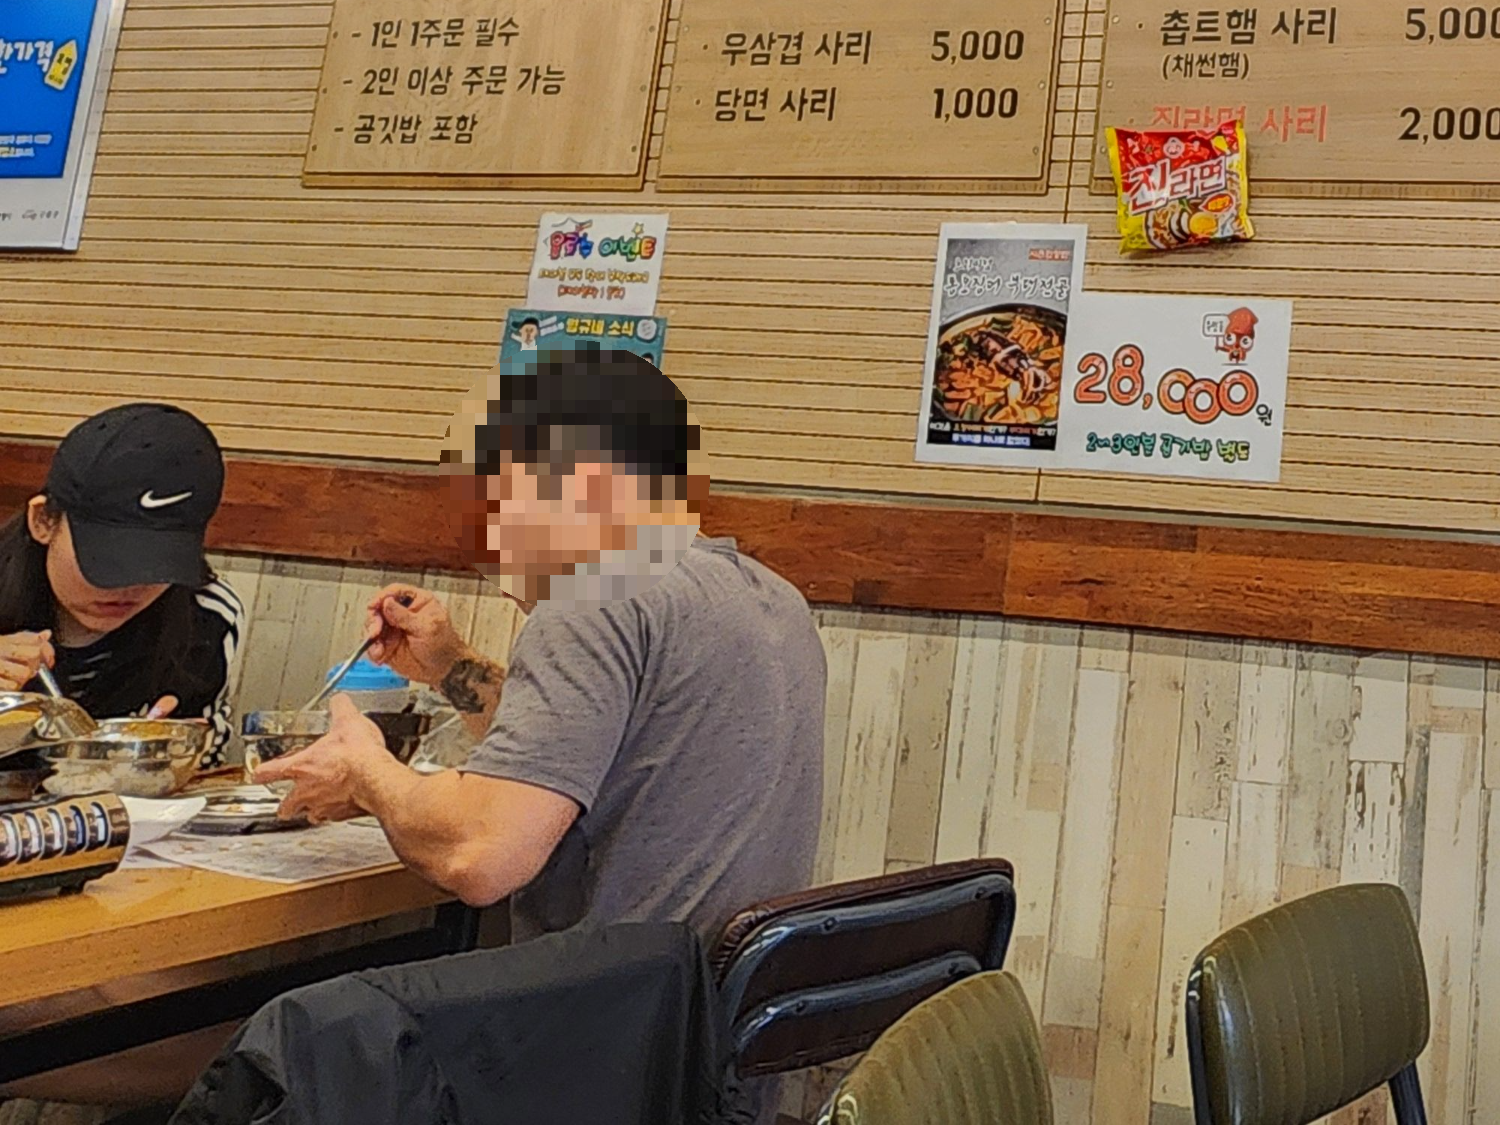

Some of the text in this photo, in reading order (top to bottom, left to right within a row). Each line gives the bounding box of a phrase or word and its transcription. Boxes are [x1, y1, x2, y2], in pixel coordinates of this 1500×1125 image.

[371, 17, 520, 48] 1인 1주문 필수
[1271, 7, 1338, 44] 사리
[721, 30, 1025, 66] 우삼겹 사리 5,000
[1162, 52, 1250, 79] (채썬햄)
[361, 65, 566, 96] 2인 이상 주문 가능
[715, 87, 1019, 122] 당면 사리 1,000
[354, 114, 478, 144] 공깃밥 포함
[1259, 105, 1328, 142] 사리
[1128, 155, 1228, 216] 진라면
